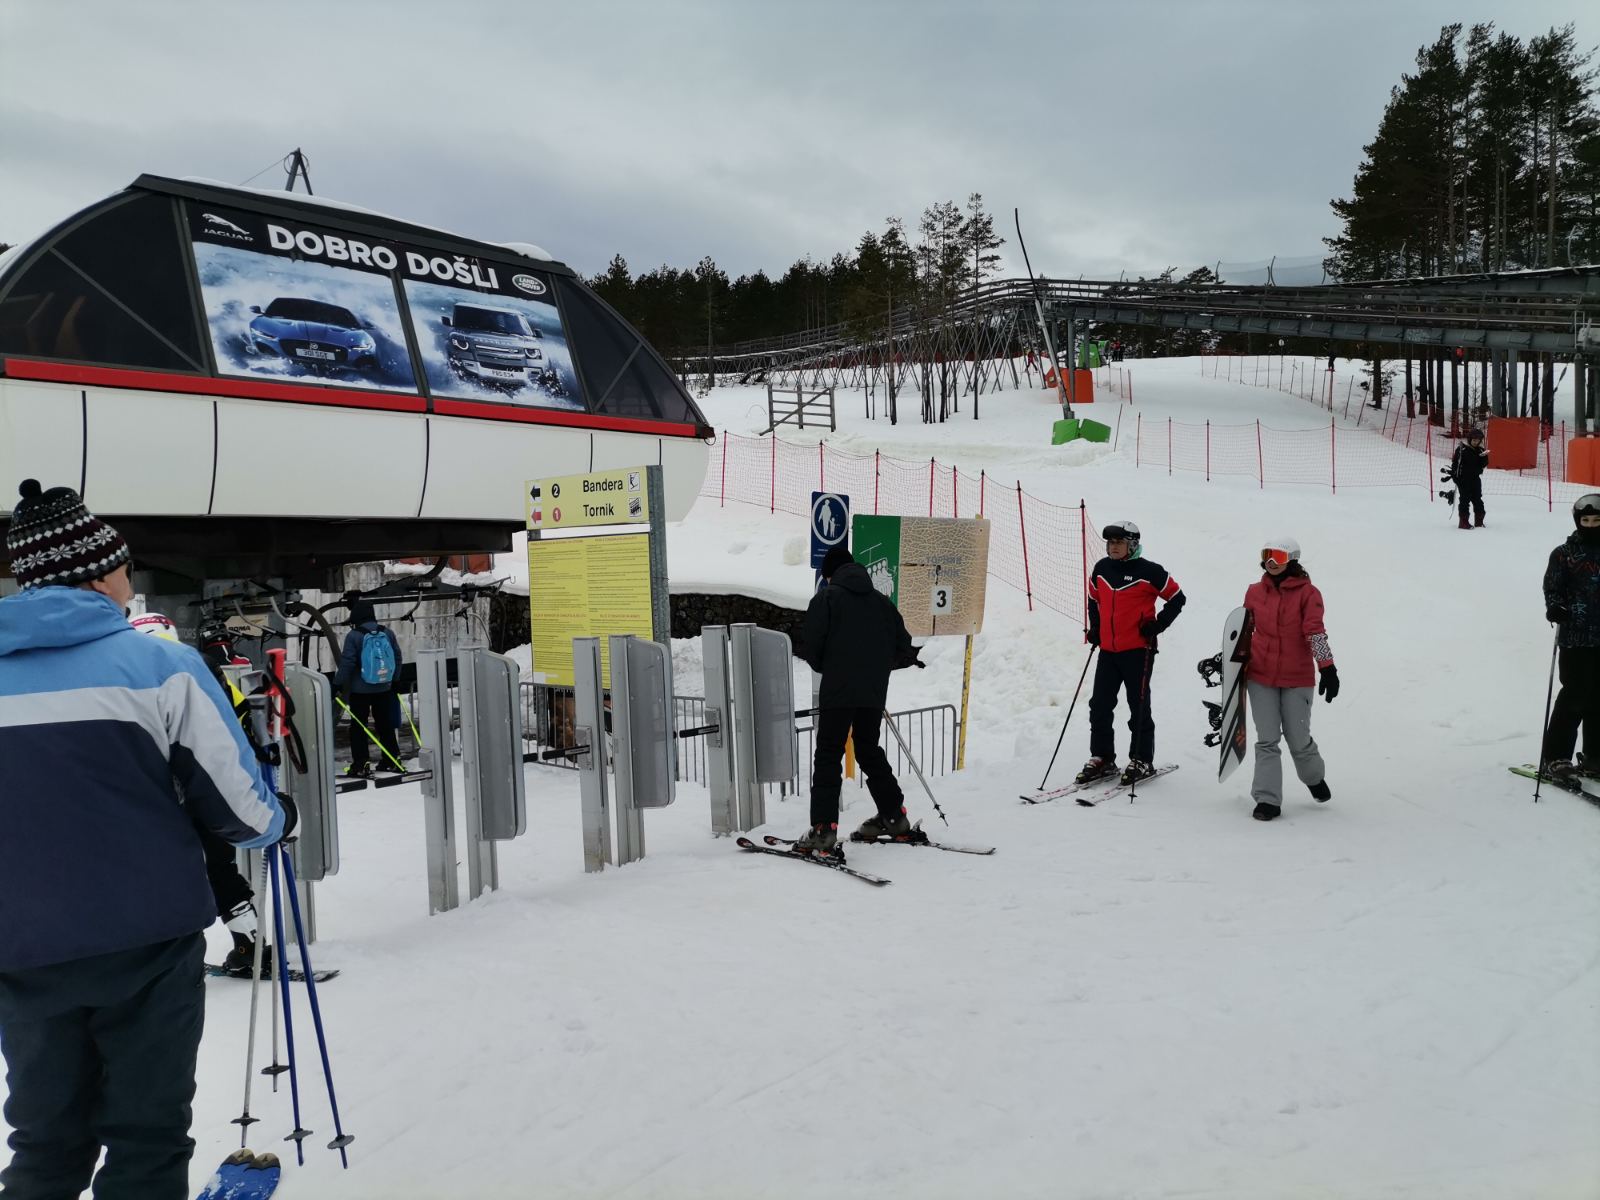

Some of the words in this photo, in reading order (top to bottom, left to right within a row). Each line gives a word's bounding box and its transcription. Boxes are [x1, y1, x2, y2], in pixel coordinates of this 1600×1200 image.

[203, 228, 255, 242] JAGUAR
[266, 223, 398, 270] DOBRO
[405, 250, 499, 289] DOŠLI
[522, 282, 541, 291] ROVER
[582, 478, 624, 493] Bandera
[582, 504, 615, 518] Tornik
[936, 590, 947, 608] 3
